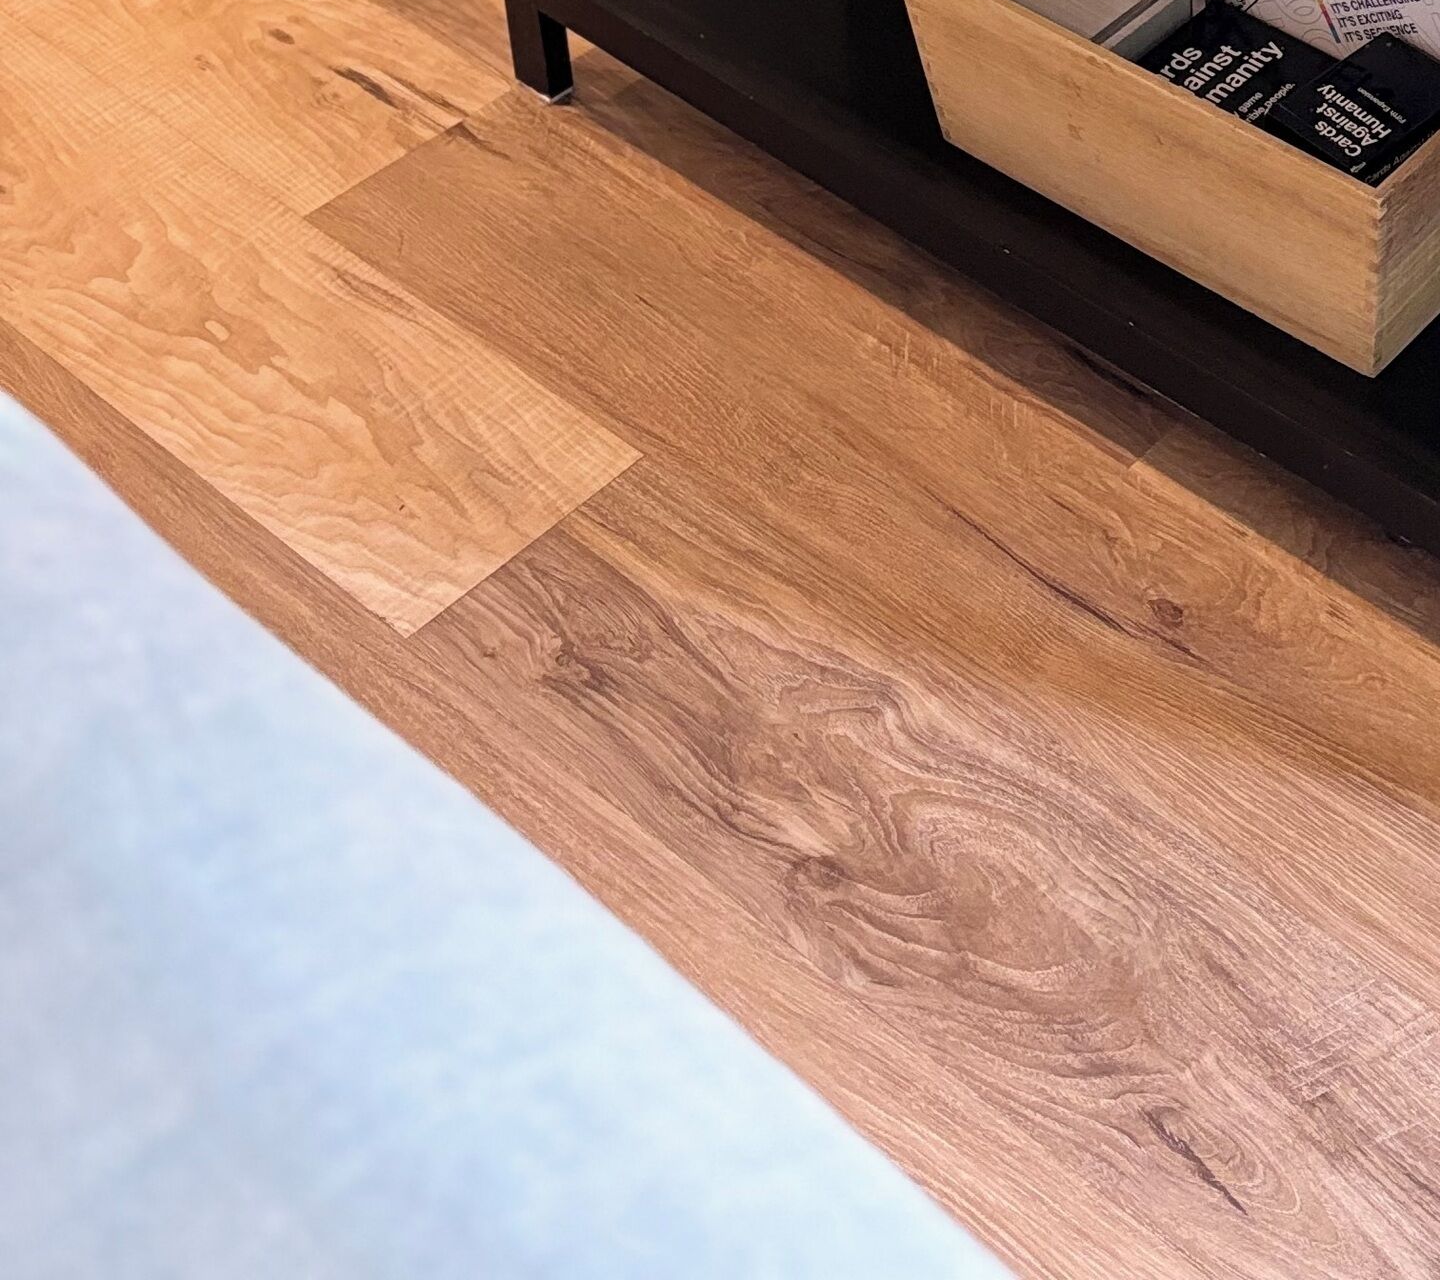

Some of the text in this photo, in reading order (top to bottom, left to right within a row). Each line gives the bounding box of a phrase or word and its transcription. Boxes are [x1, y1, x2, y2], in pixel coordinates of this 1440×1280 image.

[1330, 0, 1350, 15] IT'S
[1337, 8, 1403, 29] IT'S EXCITING
[1344, 23, 1419, 43] IT'S SEENCE
[1160, 46, 1203, 79] rds
[1183, 44, 1243, 91] ainst
[1205, 40, 1284, 104] manity
[1238, 91, 1264, 114] game
[1245, 106, 1266, 123] rible
[1316, 83, 1393, 139] Humanity
[1356, 87, 1391, 114] Expansion
[1314, 120, 1363, 158] Cards
[1315, 102, 1380, 148] Against
